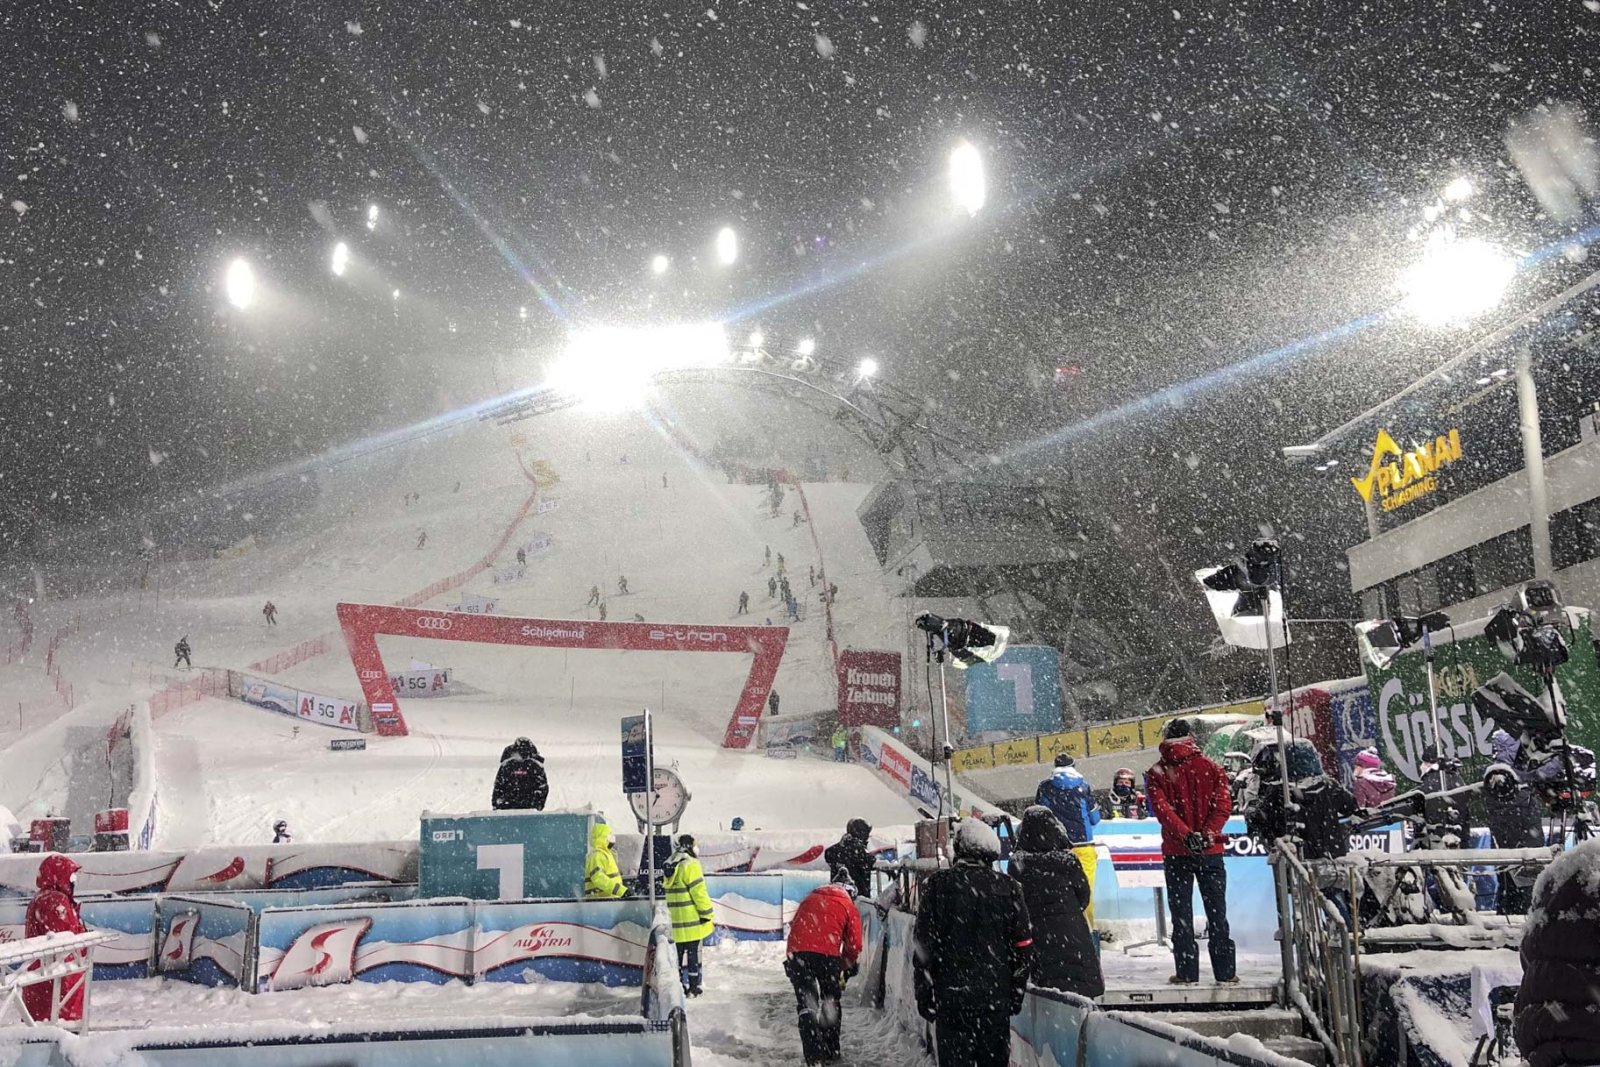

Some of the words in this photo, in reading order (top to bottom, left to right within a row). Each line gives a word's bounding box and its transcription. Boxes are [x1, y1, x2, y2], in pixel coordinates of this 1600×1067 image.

[1378, 428, 1462, 497] PLANAI
[1382, 477, 1437, 512] SCHLADMING
[521, 626, 584, 640] Schladming
[649, 629, 727, 641] e-tron
[409, 677, 426, 689] 5G
[432, 671, 448, 691] A1
[848, 667, 896, 687] Kronen
[847, 687, 896, 707] Zeitung
[300, 697, 315, 716] A1
[318, 704, 335, 718] 5G
[339, 705, 355, 724] A1
[1379, 677, 1495, 783] Gösse
[1349, 834, 1387, 852] SPORT
[513, 938, 571, 949] AUSTRIA
